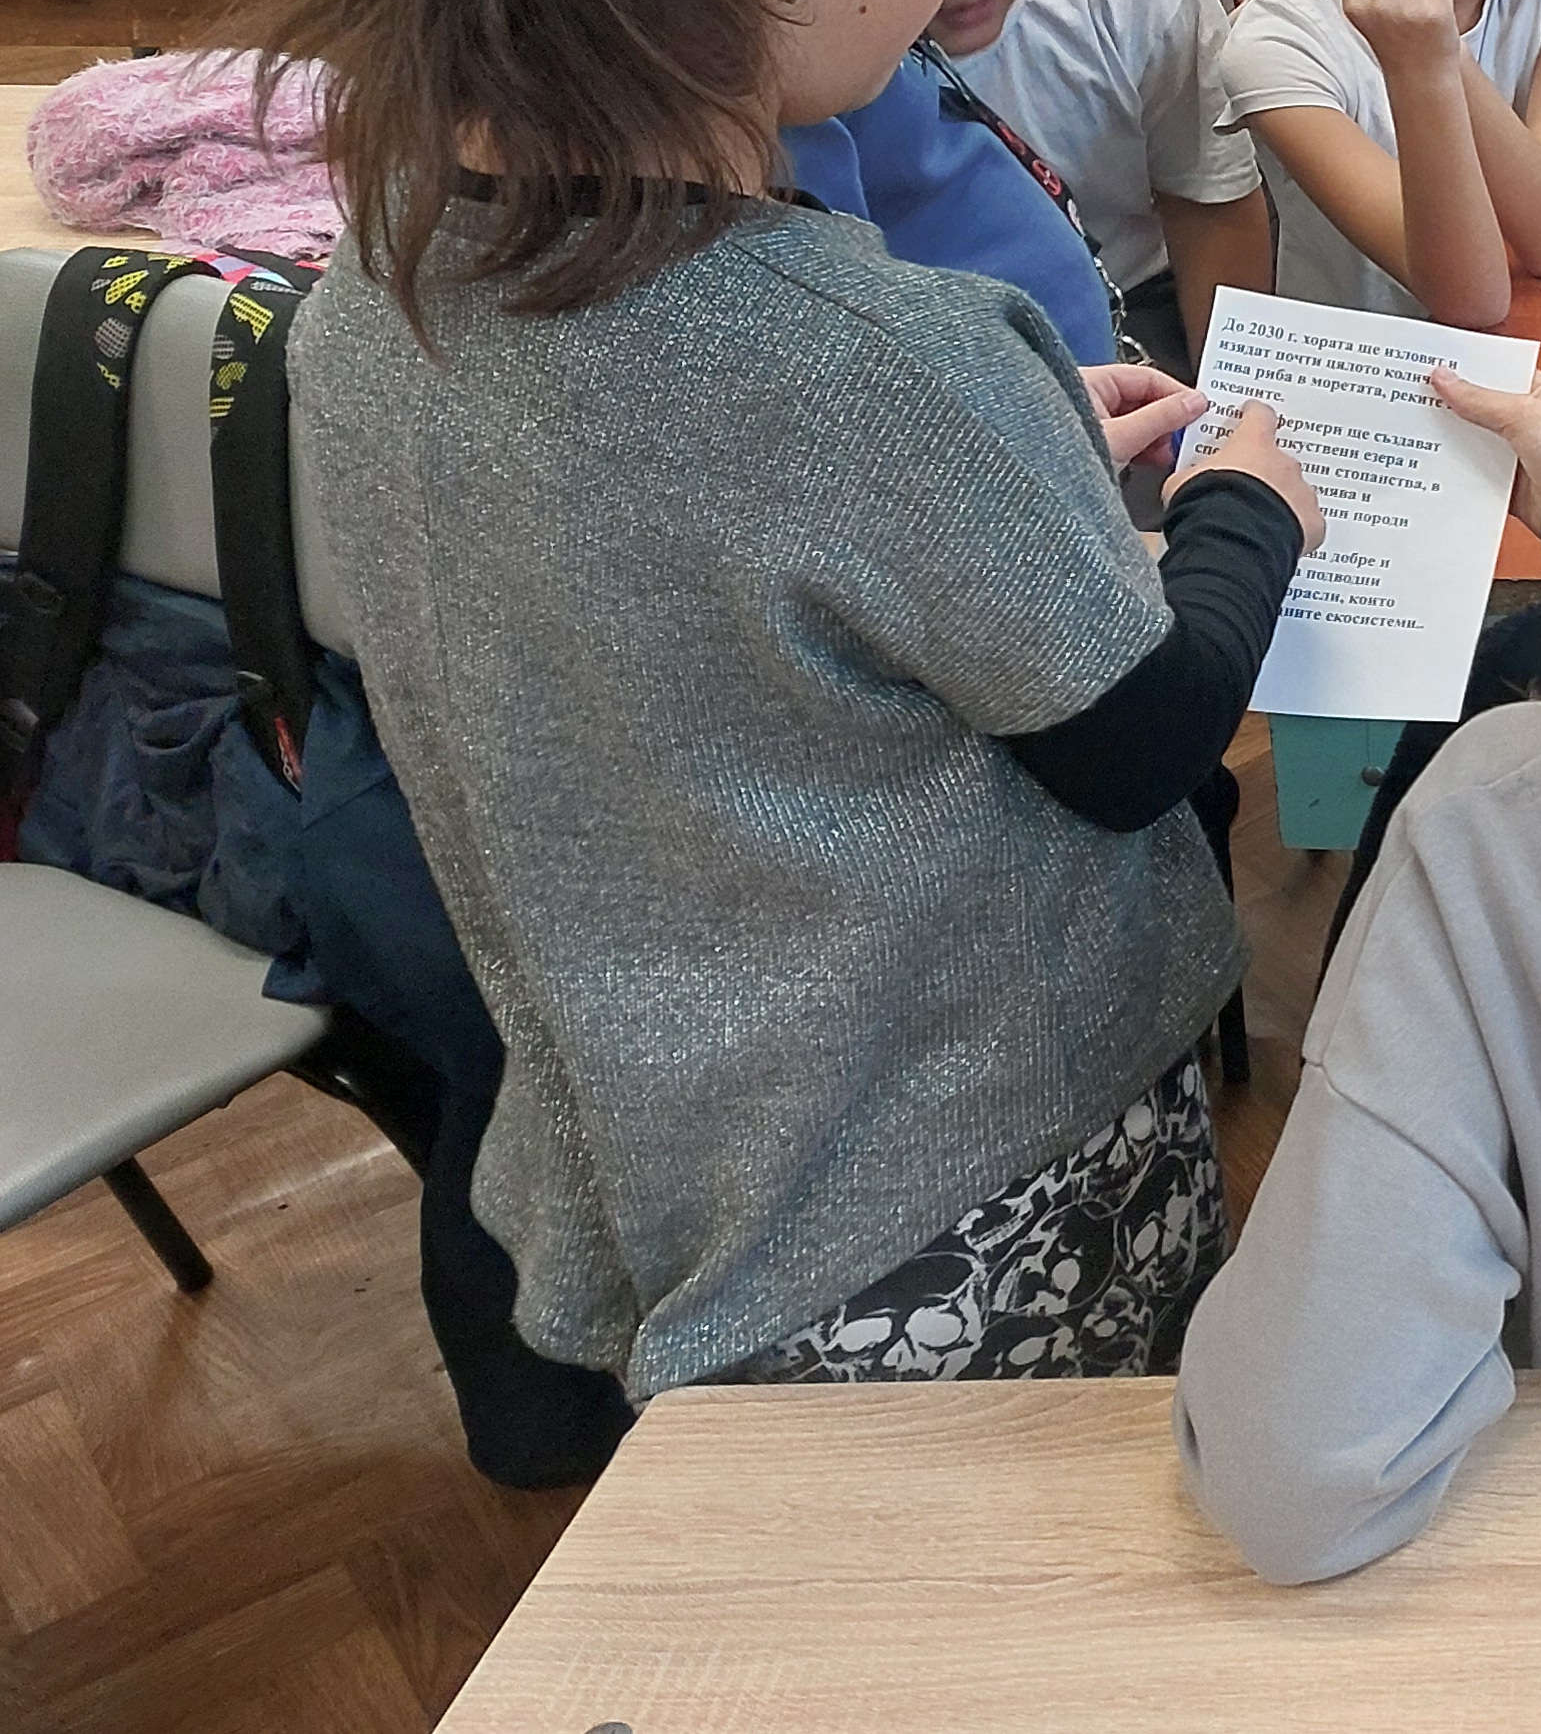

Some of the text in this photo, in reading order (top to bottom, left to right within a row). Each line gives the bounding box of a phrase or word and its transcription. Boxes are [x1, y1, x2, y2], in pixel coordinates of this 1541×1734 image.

[1221, 317, 1245, 333] До
[1248, 321, 1284, 340] 2030
[1302, 335, 1354, 353] хората
[1357, 343, 1381, 356] ще
[1384, 347, 1445, 367] изловят
[1448, 359, 1459, 370] и
[1218, 339, 1272, 360] изядат
[1275, 349, 1322, 367] почти
[1325, 357, 1380, 376] цялото
[1213, 359, 1251, 376] дива
[1254, 366, 1292, 383] риба
[1297, 374, 1307, 384] в
[1390, 387, 1443, 409] реките
[1347, 427, 1371, 441] ще
[1373, 430, 1442, 452] създават
[1363, 452, 1404, 469] езера
[1407, 459, 1419, 469] и
[1431, 483, 1441, 492] в
[1353, 511, 1410, 528] породи
[1330, 550, 1376, 568] добре
[1380, 558, 1391, 569] и
[1348, 593, 1396, 608] които
